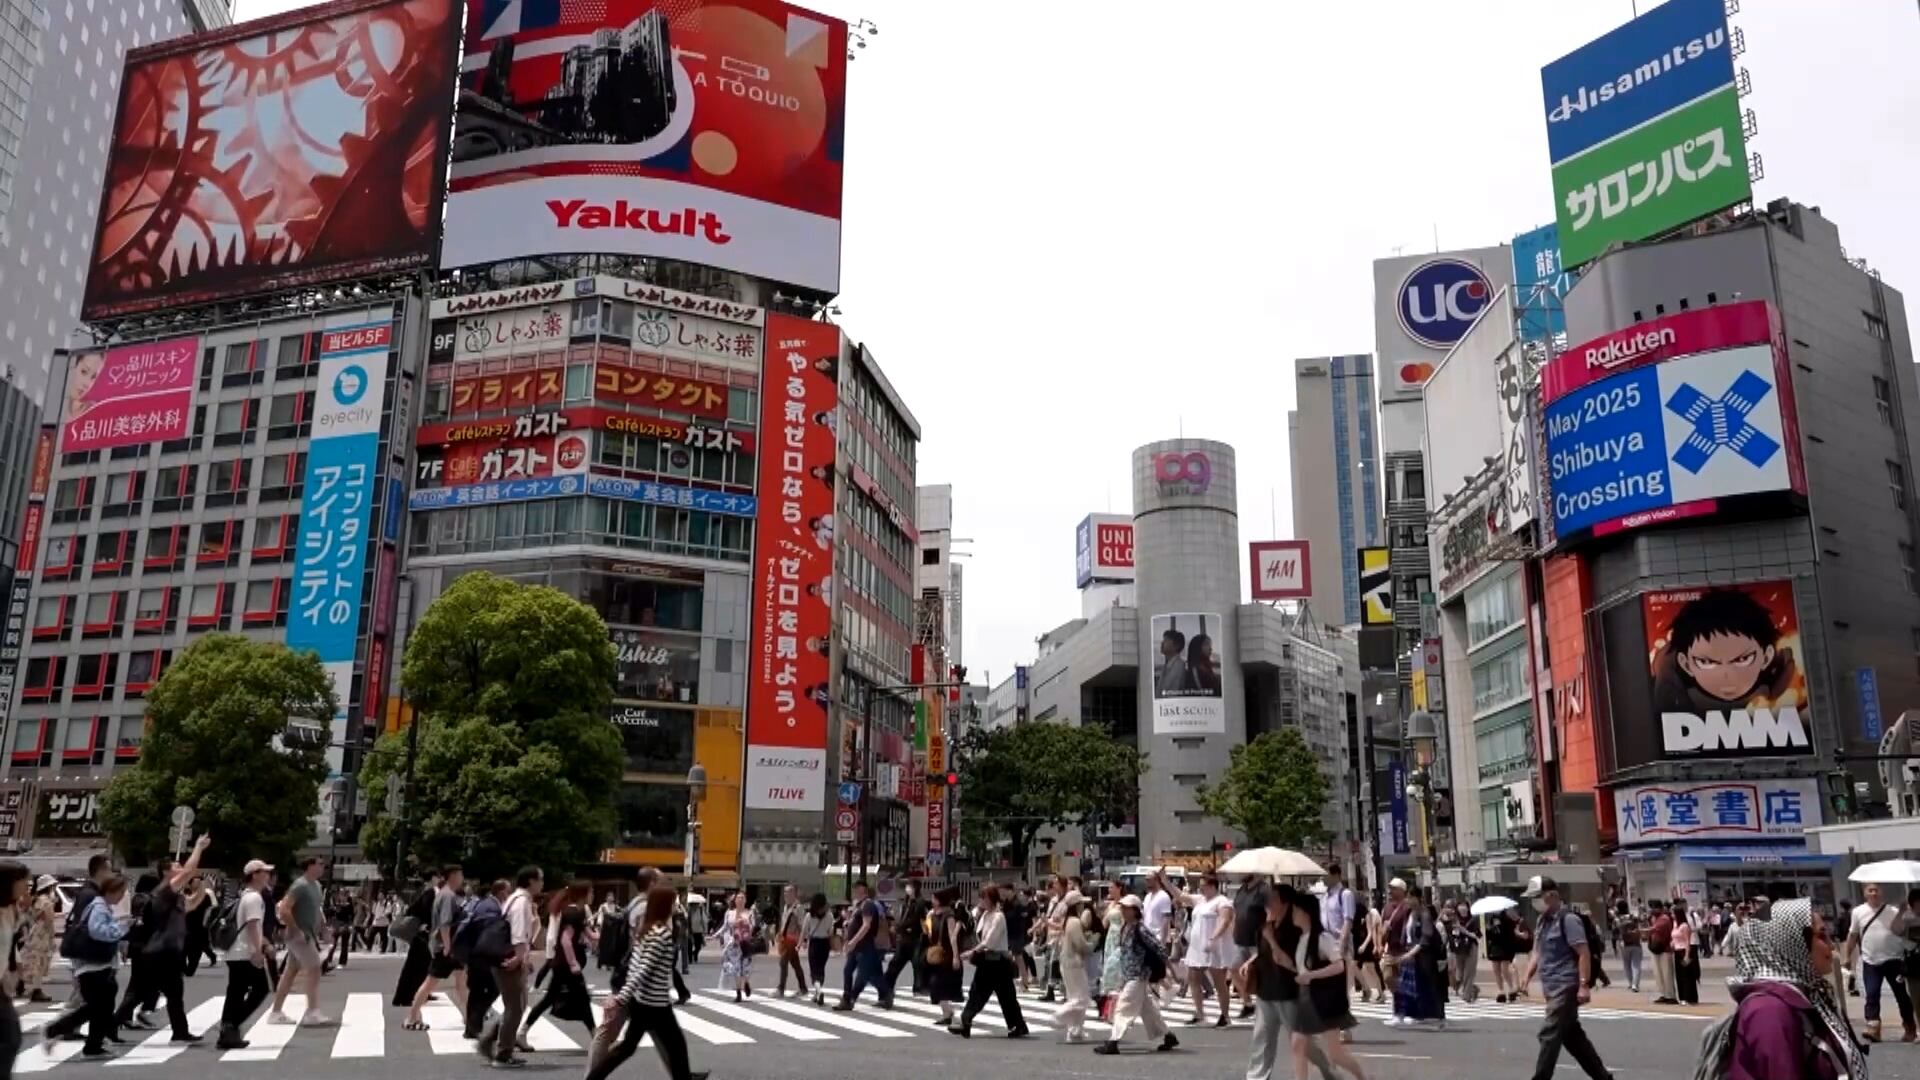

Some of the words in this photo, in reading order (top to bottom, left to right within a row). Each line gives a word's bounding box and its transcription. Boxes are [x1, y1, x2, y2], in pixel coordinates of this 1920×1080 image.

[694, 72, 707, 87] A
[716, 75, 801, 112] TÓQUIO
[1548, 28, 1725, 122] Hisamitsu
[1566, 127, 1732, 231] サロンパス
[546, 199, 732, 245] Yakult
[329, 328, 385, 350] 当ビル5F
[434, 333, 455, 350] 9F
[495, 311, 562, 344] しゃぶ葉
[677, 322, 756, 358] しゃぶ葉
[126, 347, 191, 372] 品川スキン
[1585, 327, 1676, 369] Rakuten
[124, 367, 181, 389] クリニック
[455, 371, 562, 407] プライス
[596, 368, 722, 410] コンタクト
[80, 408, 181, 442] 品川美容外科
[320, 407, 373, 429] eyecity
[513, 411, 567, 438] ガスト
[1549, 408, 1582, 441] May
[1584, 382, 1641, 423] 2025
[684, 425, 742, 451] ガスト
[782, 352, 808, 536] やる気ゼロなら、
[1552, 431, 1644, 480] Shibuya
[420, 460, 444, 479] 7F
[480, 447, 547, 480] ガスト
[456, 481, 555, 502] 英会話イーオン
[643, 483, 754, 511] 英会話イーオン
[1556, 469, 1666, 520] Crossing
[300, 465, 342, 627] アイシティ
[329, 463, 366, 624] コンタクトの
[1103, 529, 1132, 545] UNI
[775, 557, 800, 728] ゼロを見よう。
[1661, 706, 1809, 751] DMM
[768, 788, 806, 800] 17LIVE
[1622, 789, 1802, 832] 大盛堂書店
